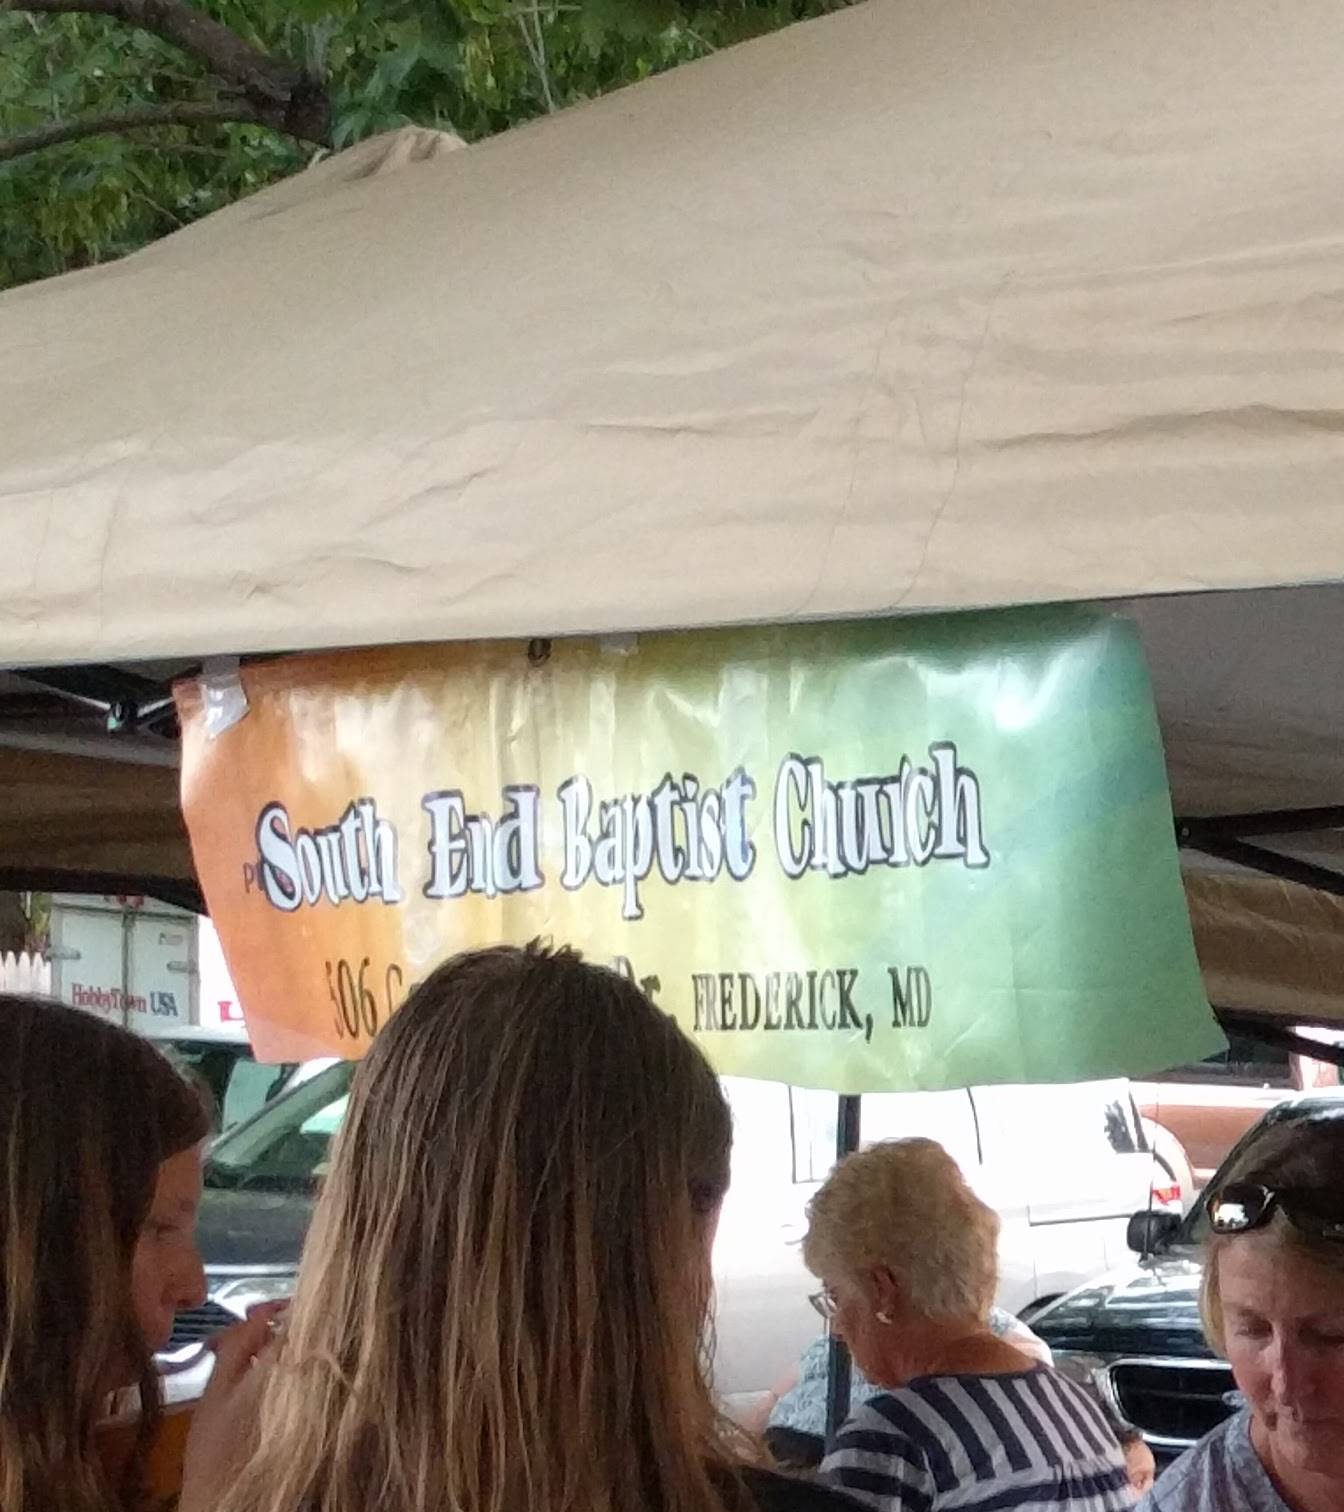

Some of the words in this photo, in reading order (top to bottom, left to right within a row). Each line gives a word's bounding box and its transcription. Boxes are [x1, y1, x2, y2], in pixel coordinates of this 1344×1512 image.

[256, 800, 401, 912] South
[421, 784, 545, 899] End
[557, 764, 756, 920] Baptist
[774, 740, 990, 880] Church
[150, 990, 178, 1017] USA
[691, 967, 874, 1043] FREDERICK,
[888, 965, 932, 1028] MD
